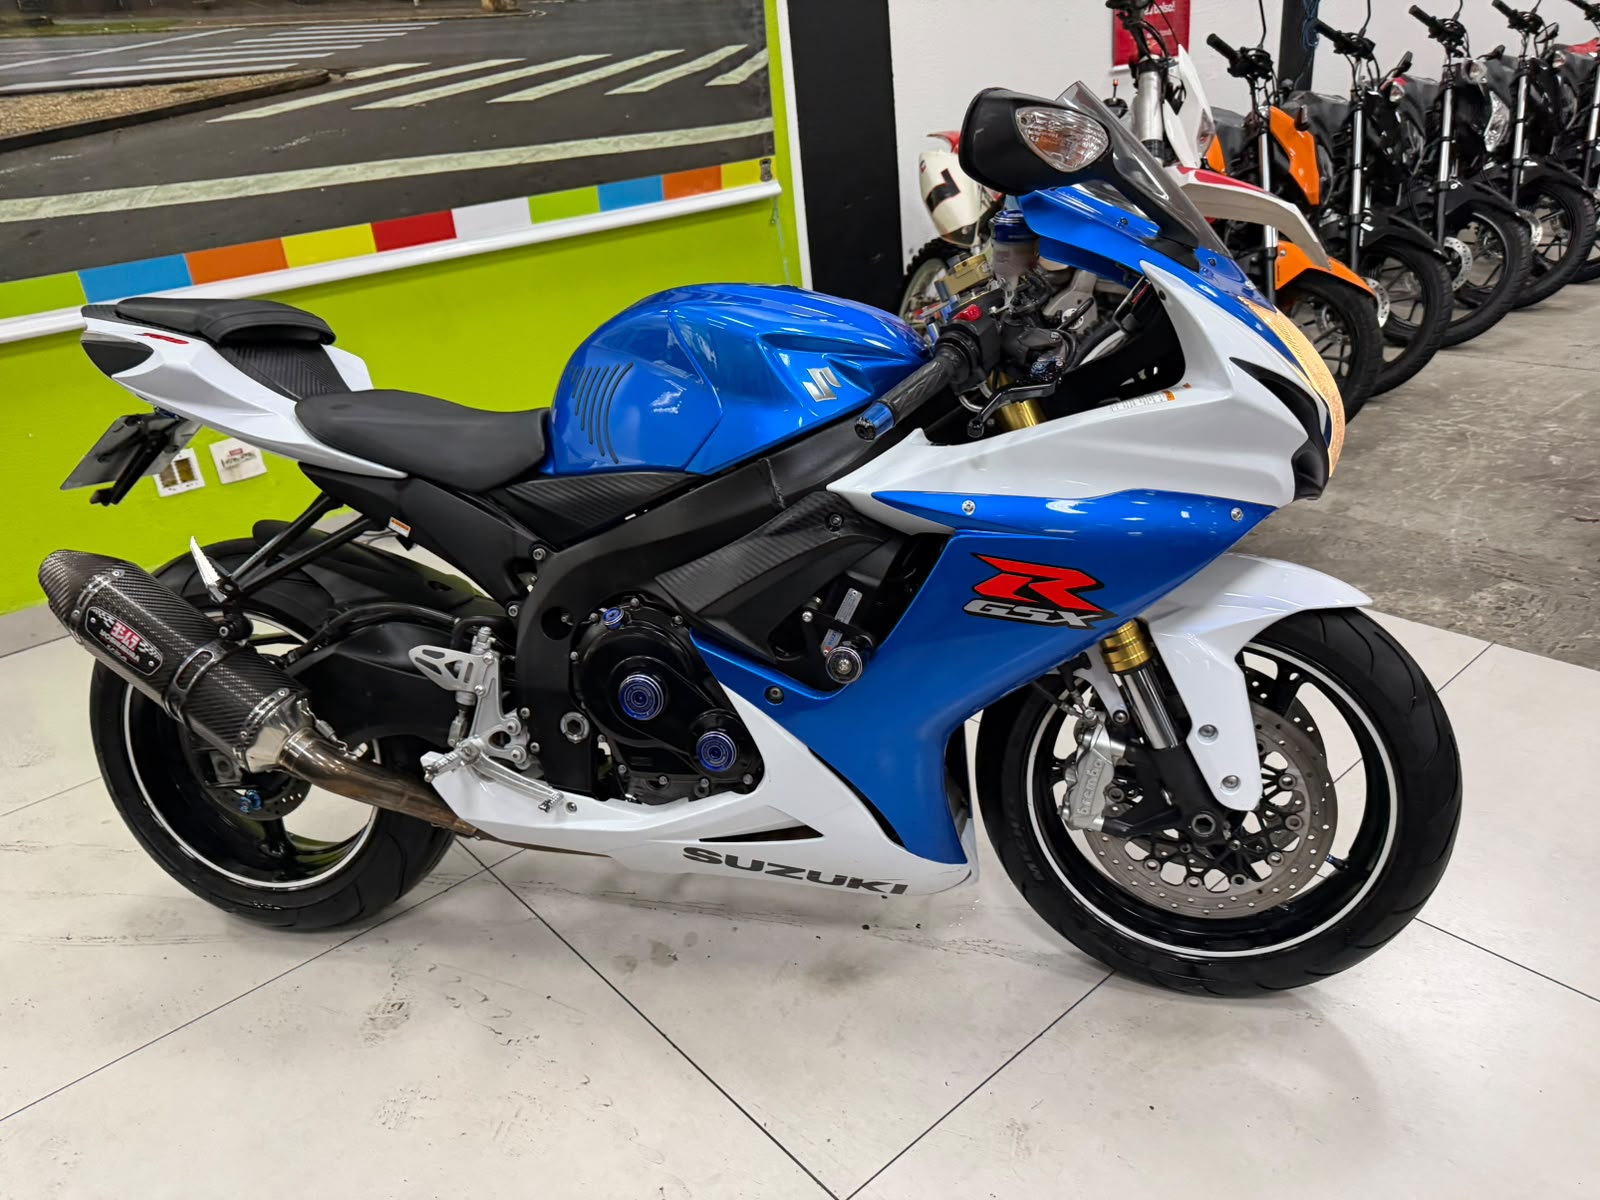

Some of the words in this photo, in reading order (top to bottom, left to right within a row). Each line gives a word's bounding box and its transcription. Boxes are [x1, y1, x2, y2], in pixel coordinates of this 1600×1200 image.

[963, 599, 1103, 628] GSX
[1076, 759, 1103, 816] brembo
[683, 847, 909, 895] SUZUKI
